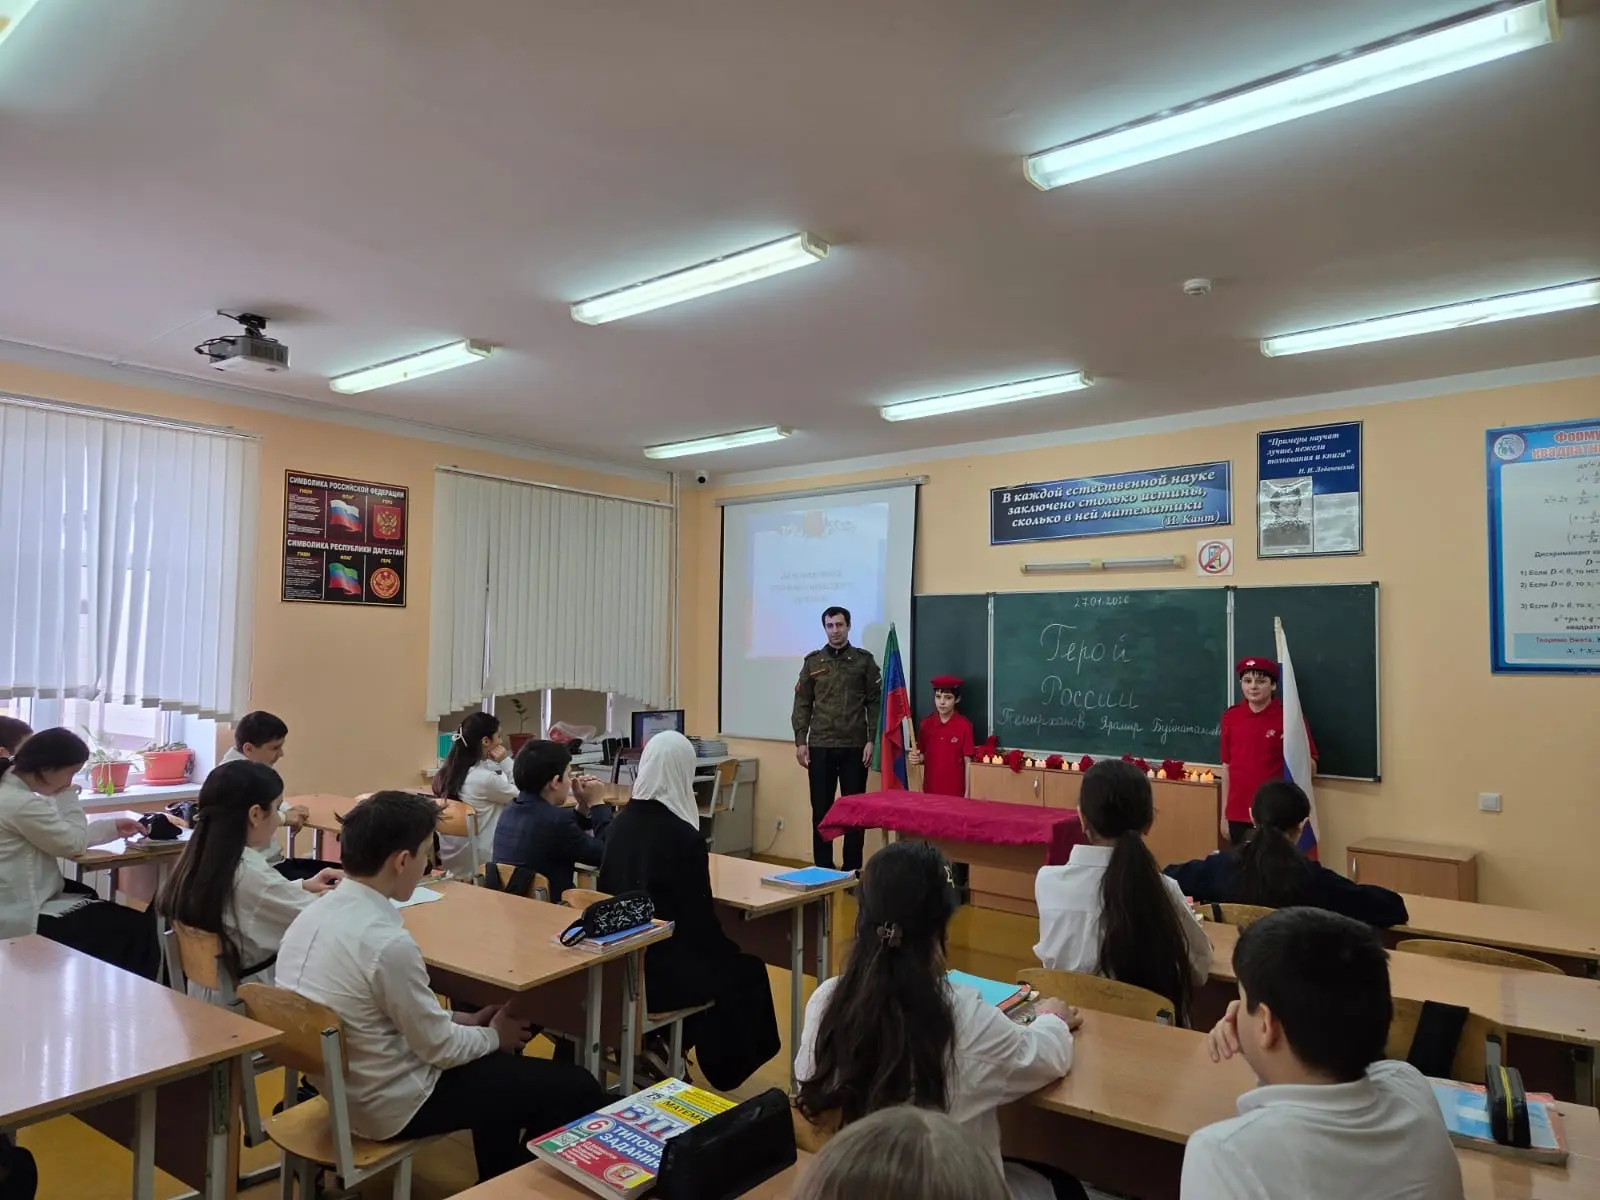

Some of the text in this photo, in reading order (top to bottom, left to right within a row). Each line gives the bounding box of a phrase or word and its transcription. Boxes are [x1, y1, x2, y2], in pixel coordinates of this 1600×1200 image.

[1310, 433, 1340, 442] научат
[1295, 444, 1326, 453] нежели
[1268, 455, 1314, 465] толкования
[289, 476, 404, 498] СИМВОЛИКА РОССИЙСКОЙ ФЕДЕРАЦИИ
[1002, 470, 1216, 503] В каждой естественной науке
[1008, 486, 1207, 516] заключено столько истины,
[1012, 501, 1204, 527] сколько в ней математики
[1182, 510, 1220, 525] Кант)
[287, 539, 404, 556] СИМВОЛИКА РЕСПУБЛИКИ ДАГЕСТАН
[1040, 623, 1131, 675] Герой
[1041, 675, 1139, 709] России
[587, 1120, 609, 1130] 6
